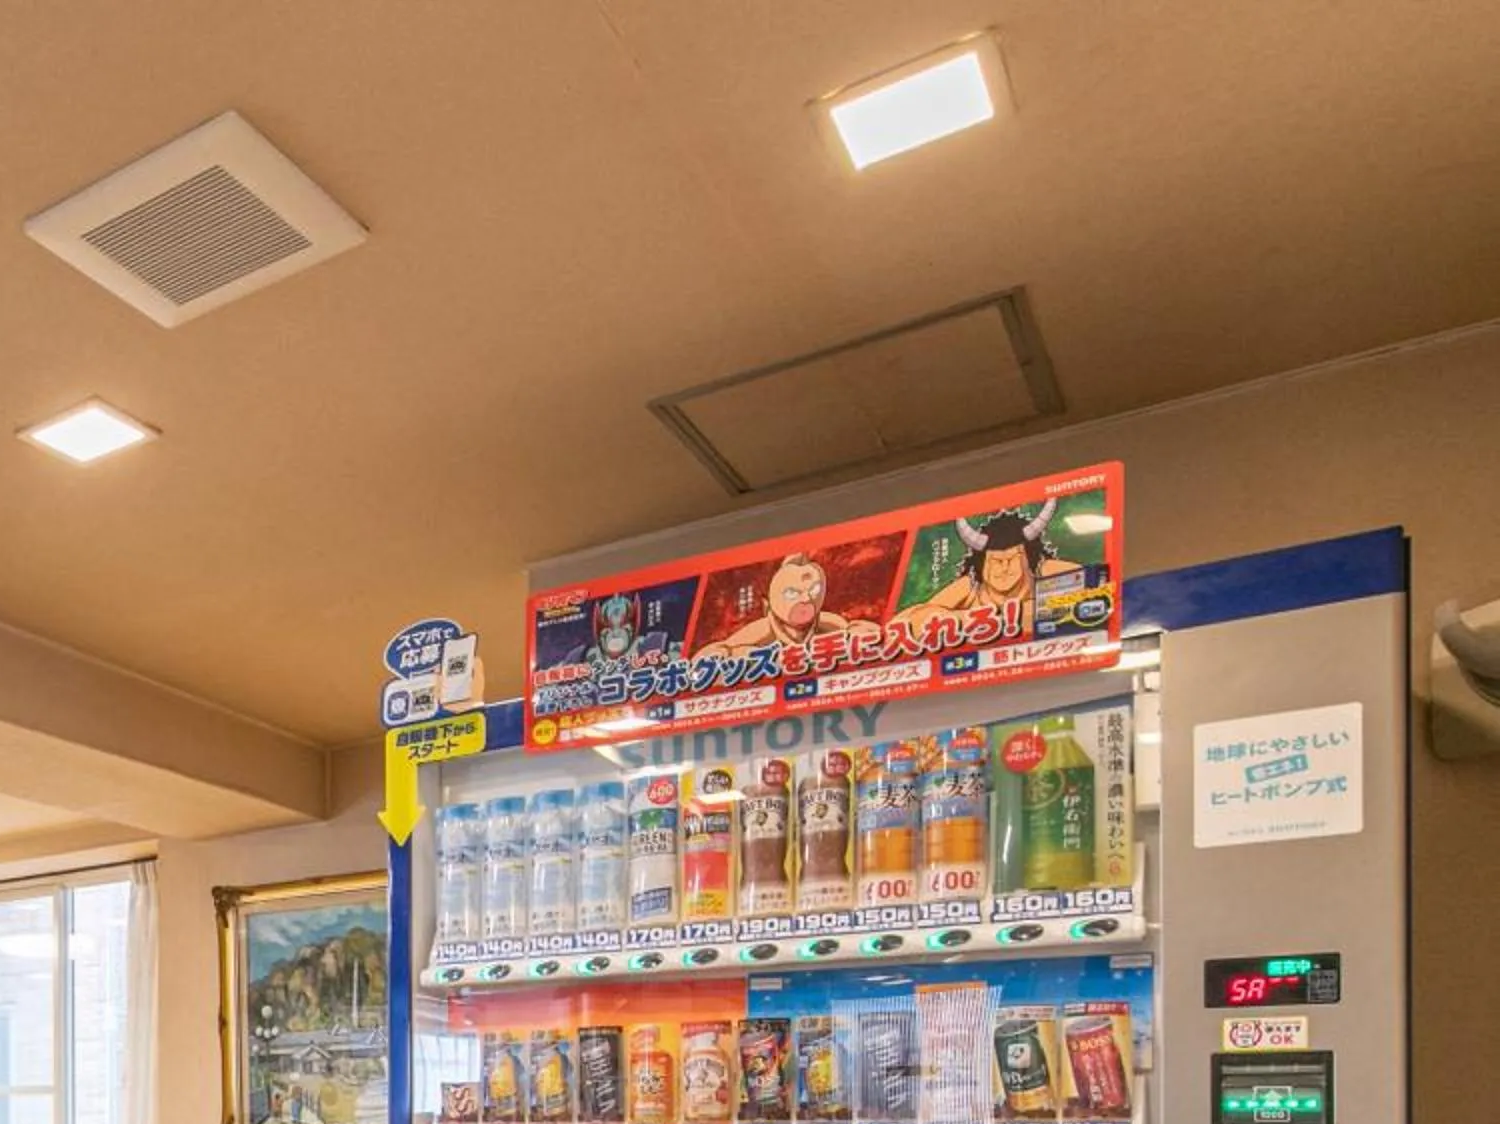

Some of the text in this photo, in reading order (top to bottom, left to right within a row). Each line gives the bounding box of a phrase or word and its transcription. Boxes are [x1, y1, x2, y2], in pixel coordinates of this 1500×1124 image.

[408, 741, 459, 760] スタート
[1206, 732, 1350, 762] 地球にやさしい
[630, 927, 675, 942] 170円
[684, 922, 731, 939] 170円
